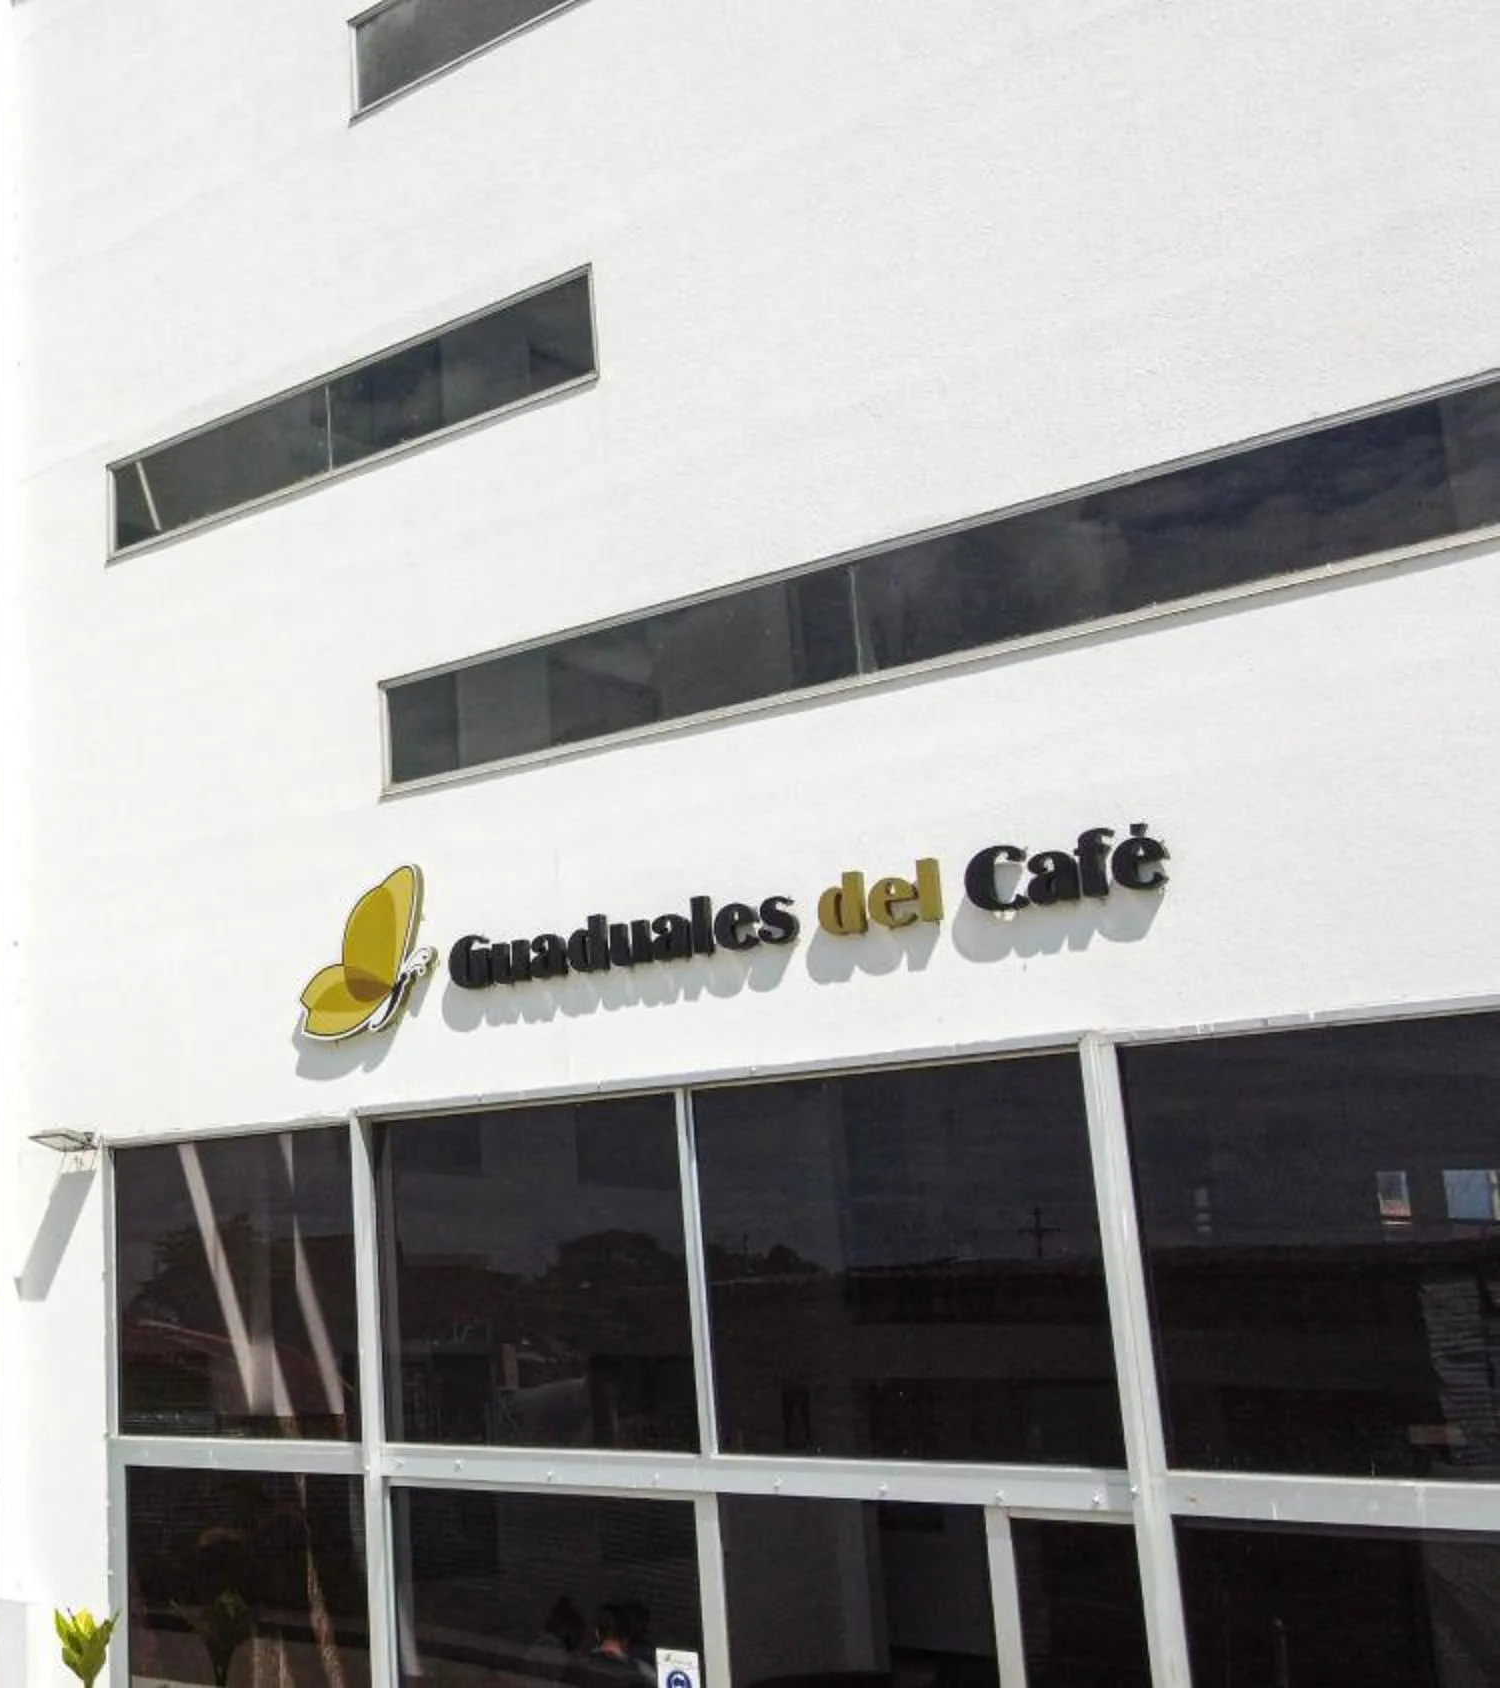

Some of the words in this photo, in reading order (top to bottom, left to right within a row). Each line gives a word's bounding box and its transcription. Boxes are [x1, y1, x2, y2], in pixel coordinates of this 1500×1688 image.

[448, 895, 800, 989] Guaduales
[817, 857, 943, 935] del
[964, 823, 1170, 912] Café
